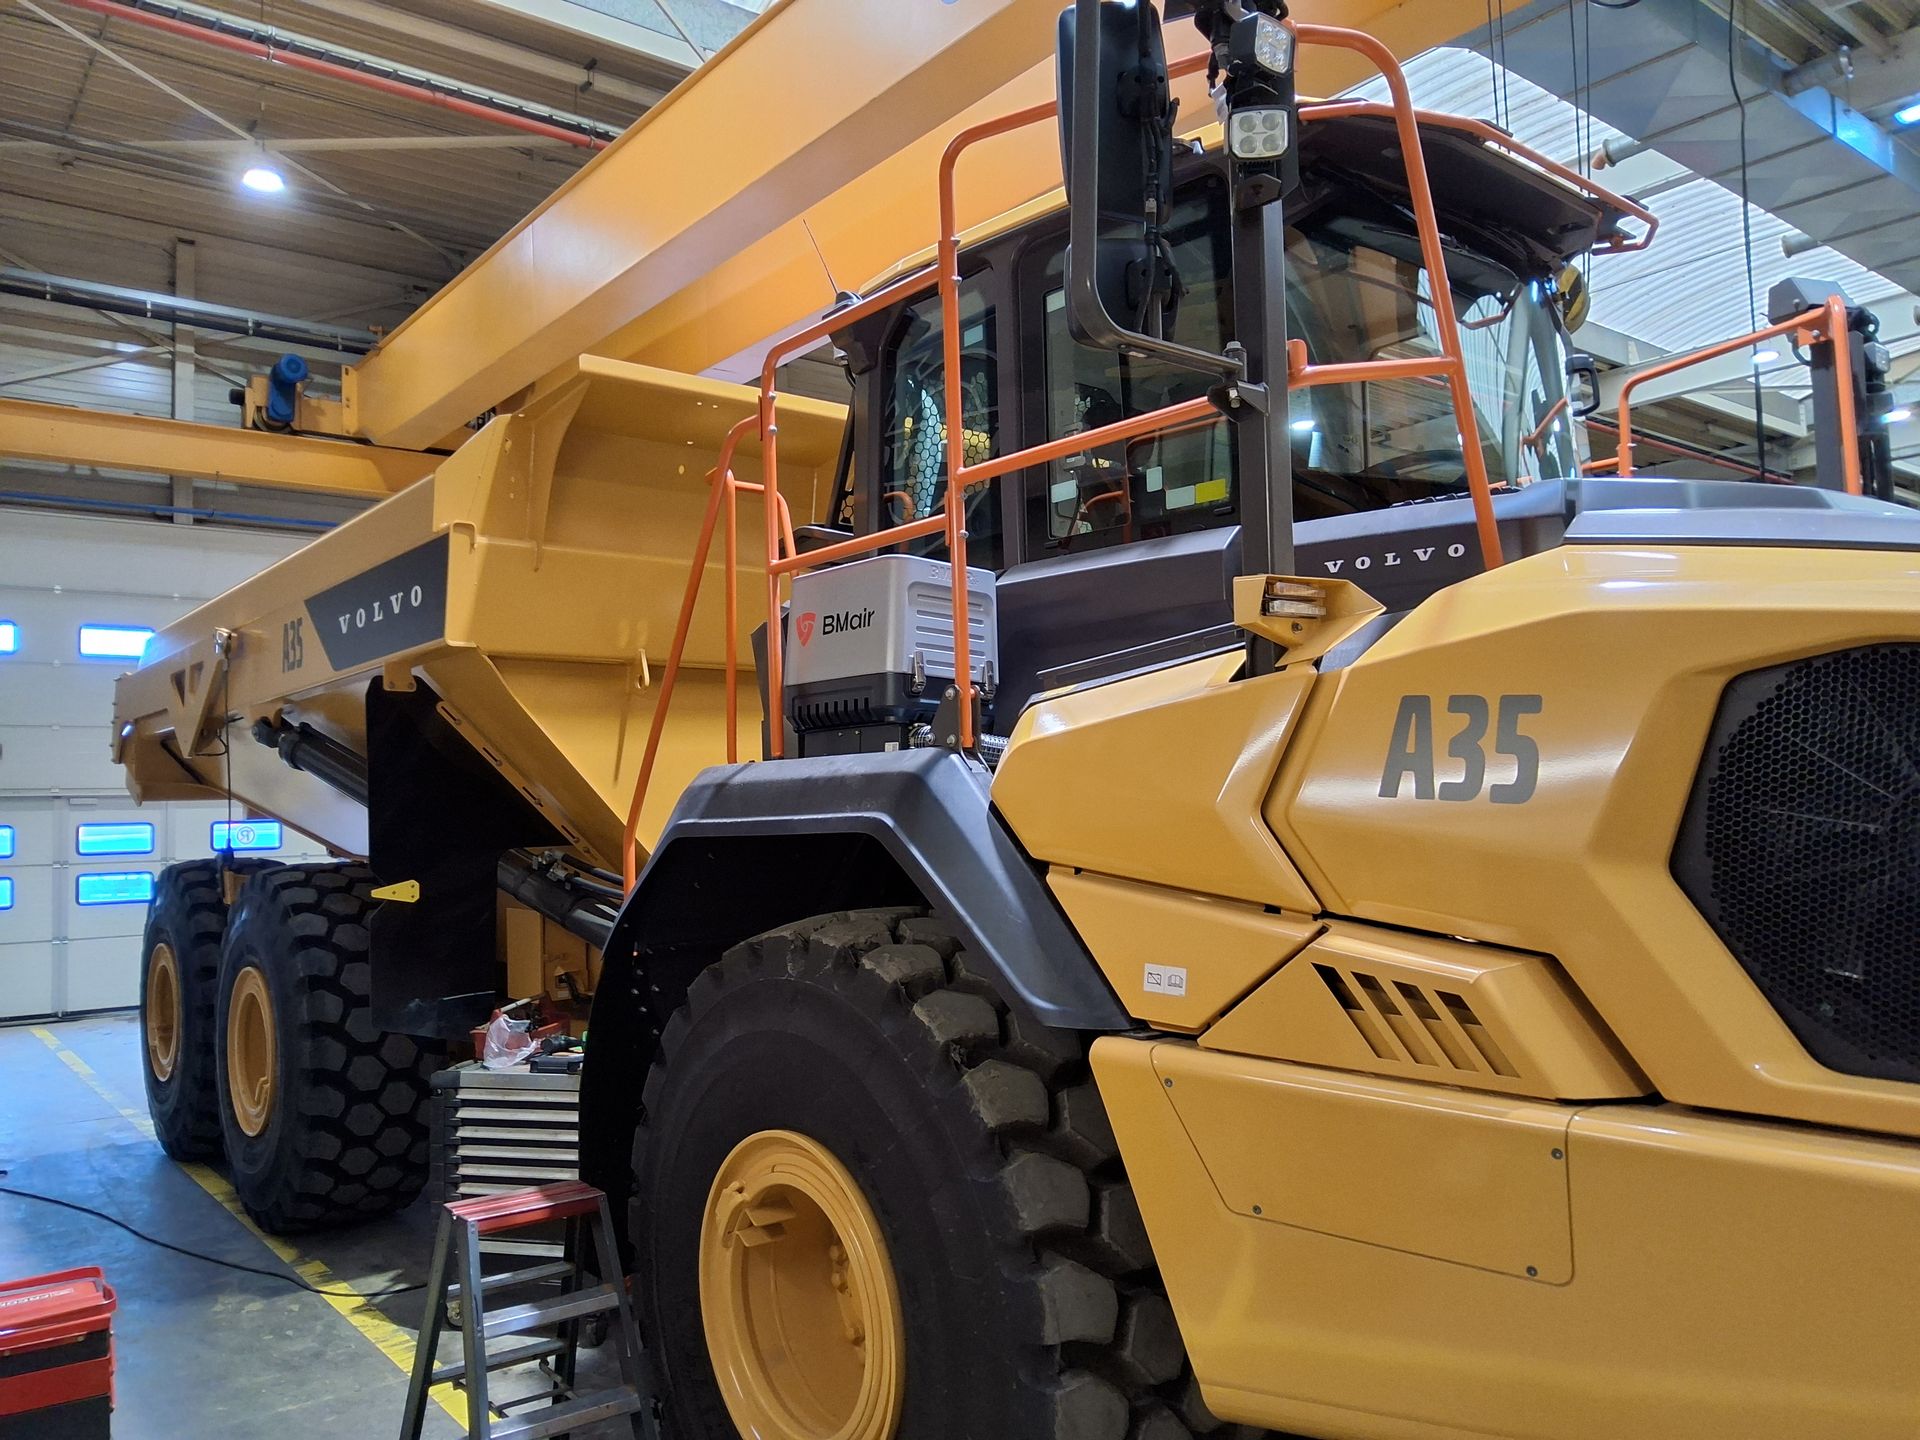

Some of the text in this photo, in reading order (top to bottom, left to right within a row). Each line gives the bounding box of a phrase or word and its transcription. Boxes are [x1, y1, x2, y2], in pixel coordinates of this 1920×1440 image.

[1324, 543, 1465, 574] VOLVO
[338, 585, 422, 634] VOLVO
[822, 607, 875, 636] BMair
[282, 617, 303, 673] A35
[1378, 694, 1543, 804] A35
